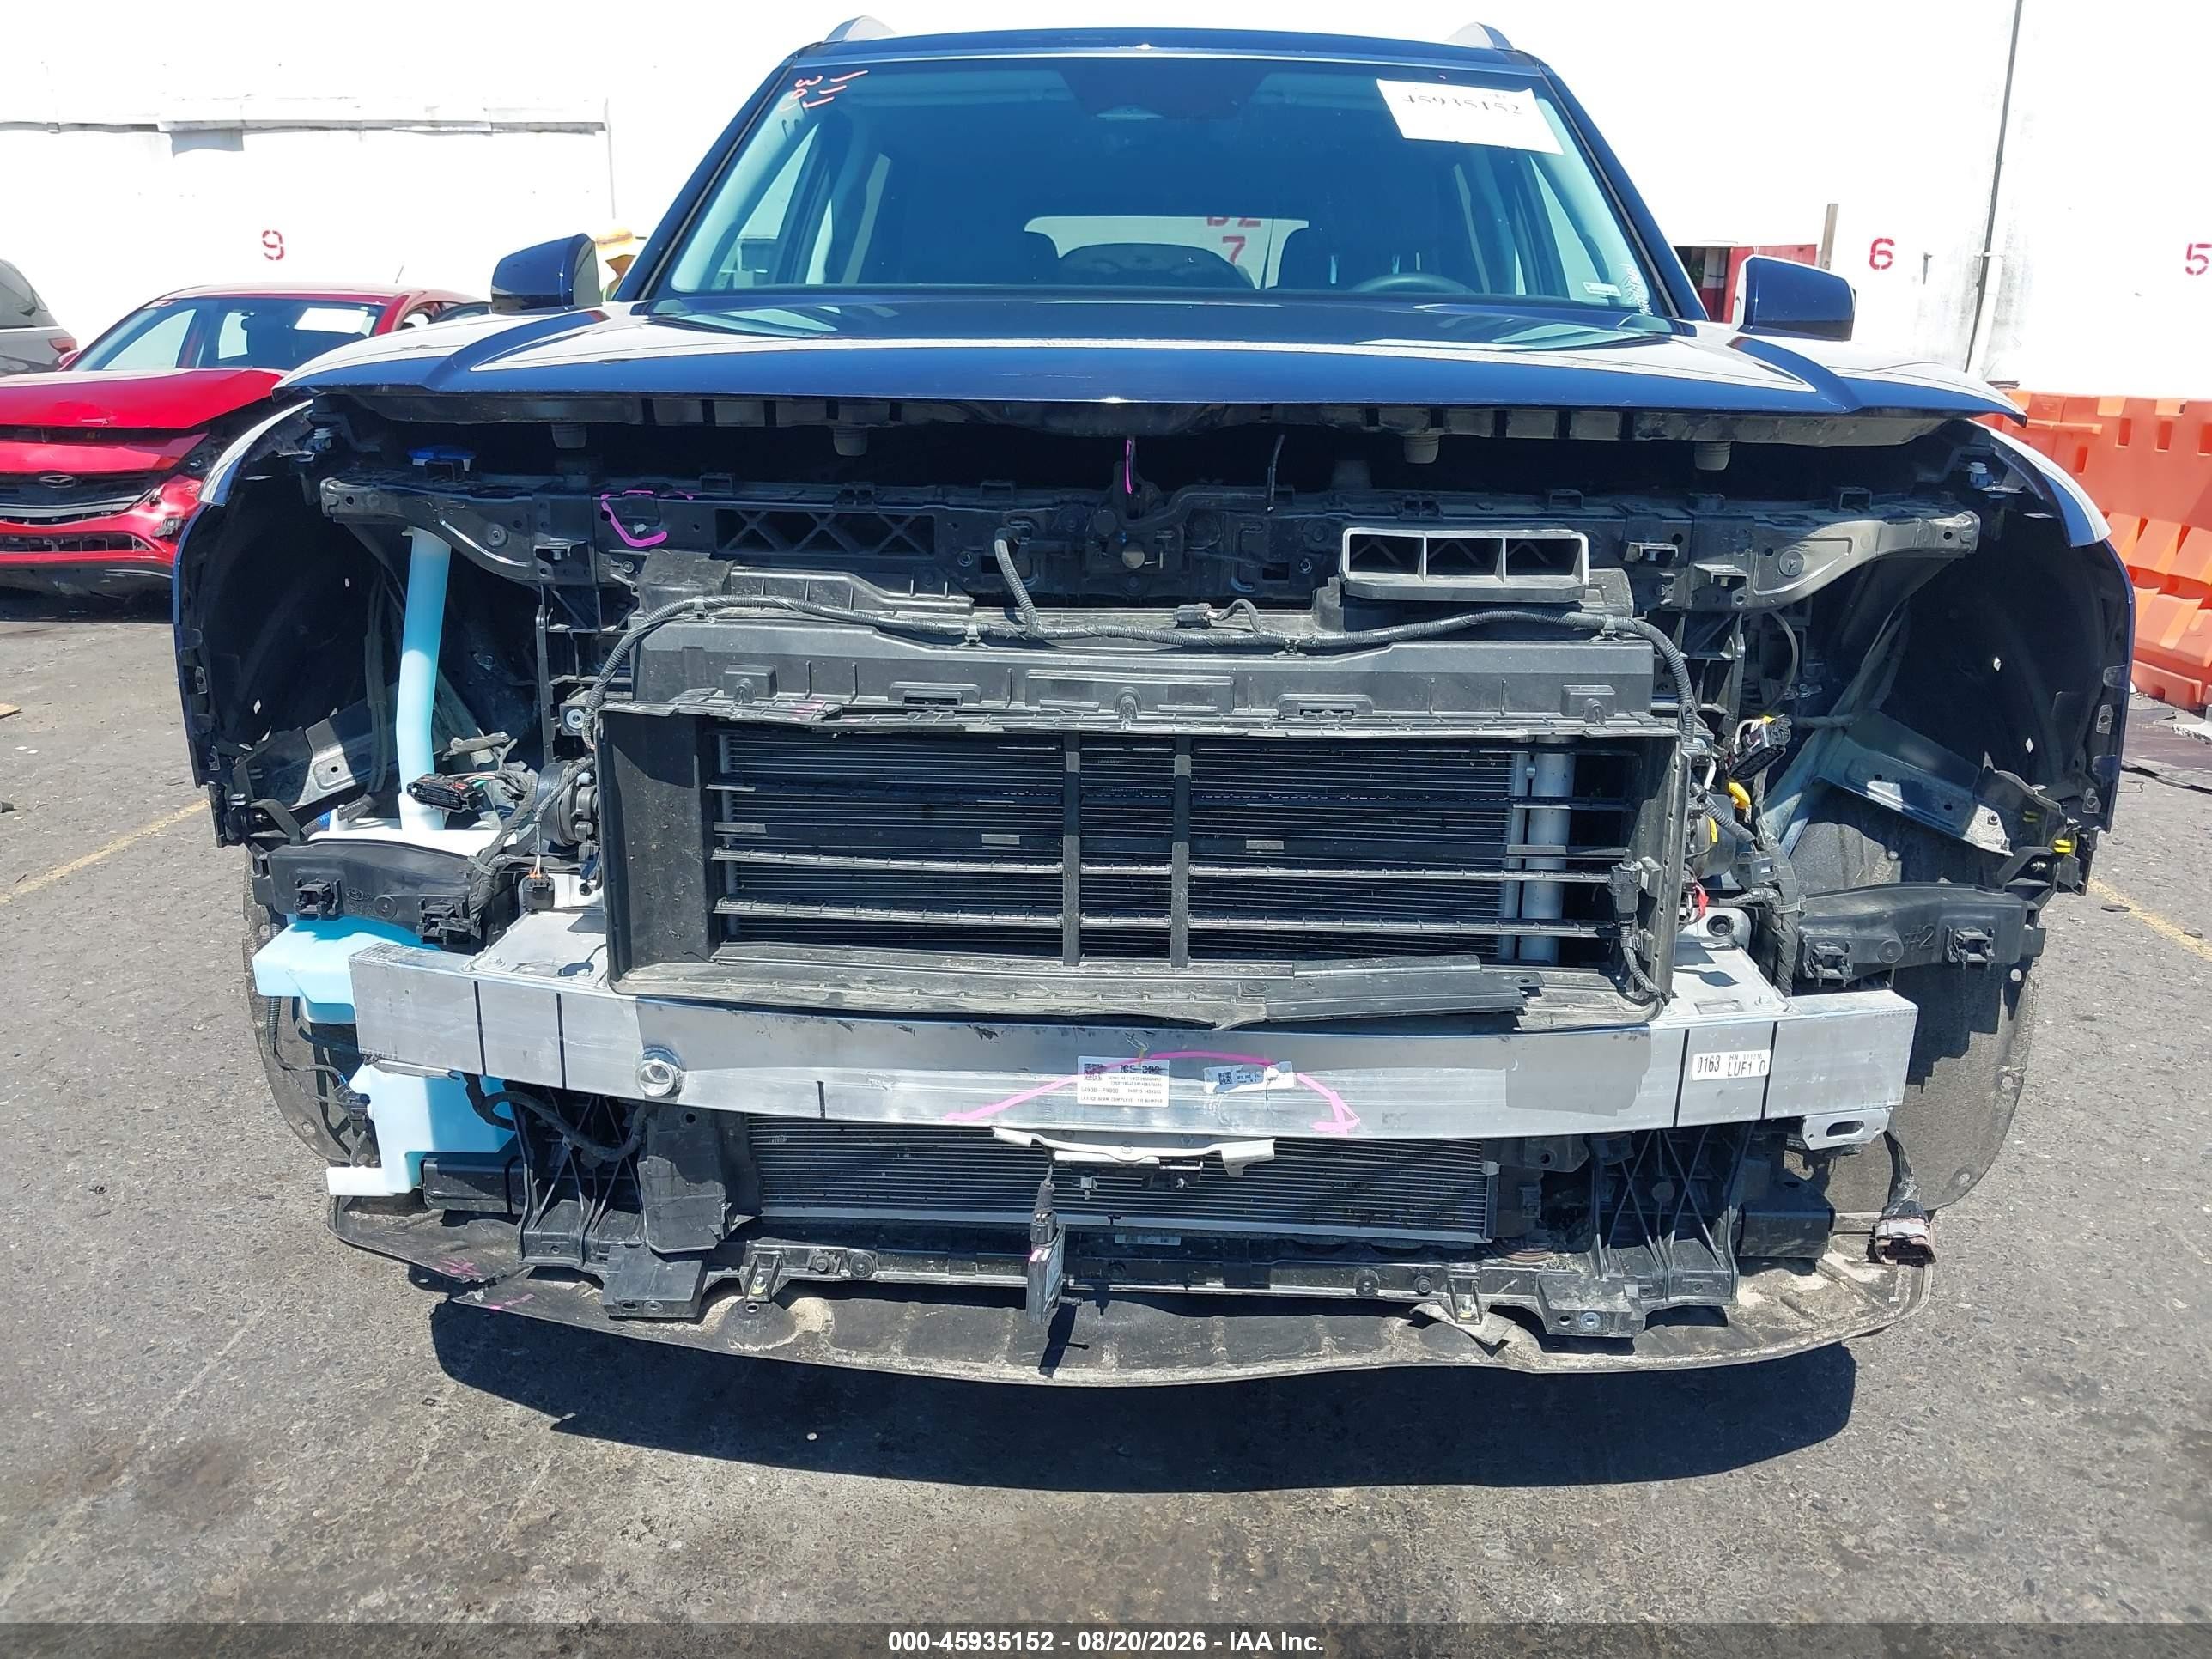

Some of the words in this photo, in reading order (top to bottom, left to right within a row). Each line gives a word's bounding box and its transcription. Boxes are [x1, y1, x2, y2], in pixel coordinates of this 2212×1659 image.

[262, 229, 284, 261] 9
[1223, 235, 1246, 264] 7
[1869, 237, 1896, 270] 6
[2184, 242, 2212, 276] 5
